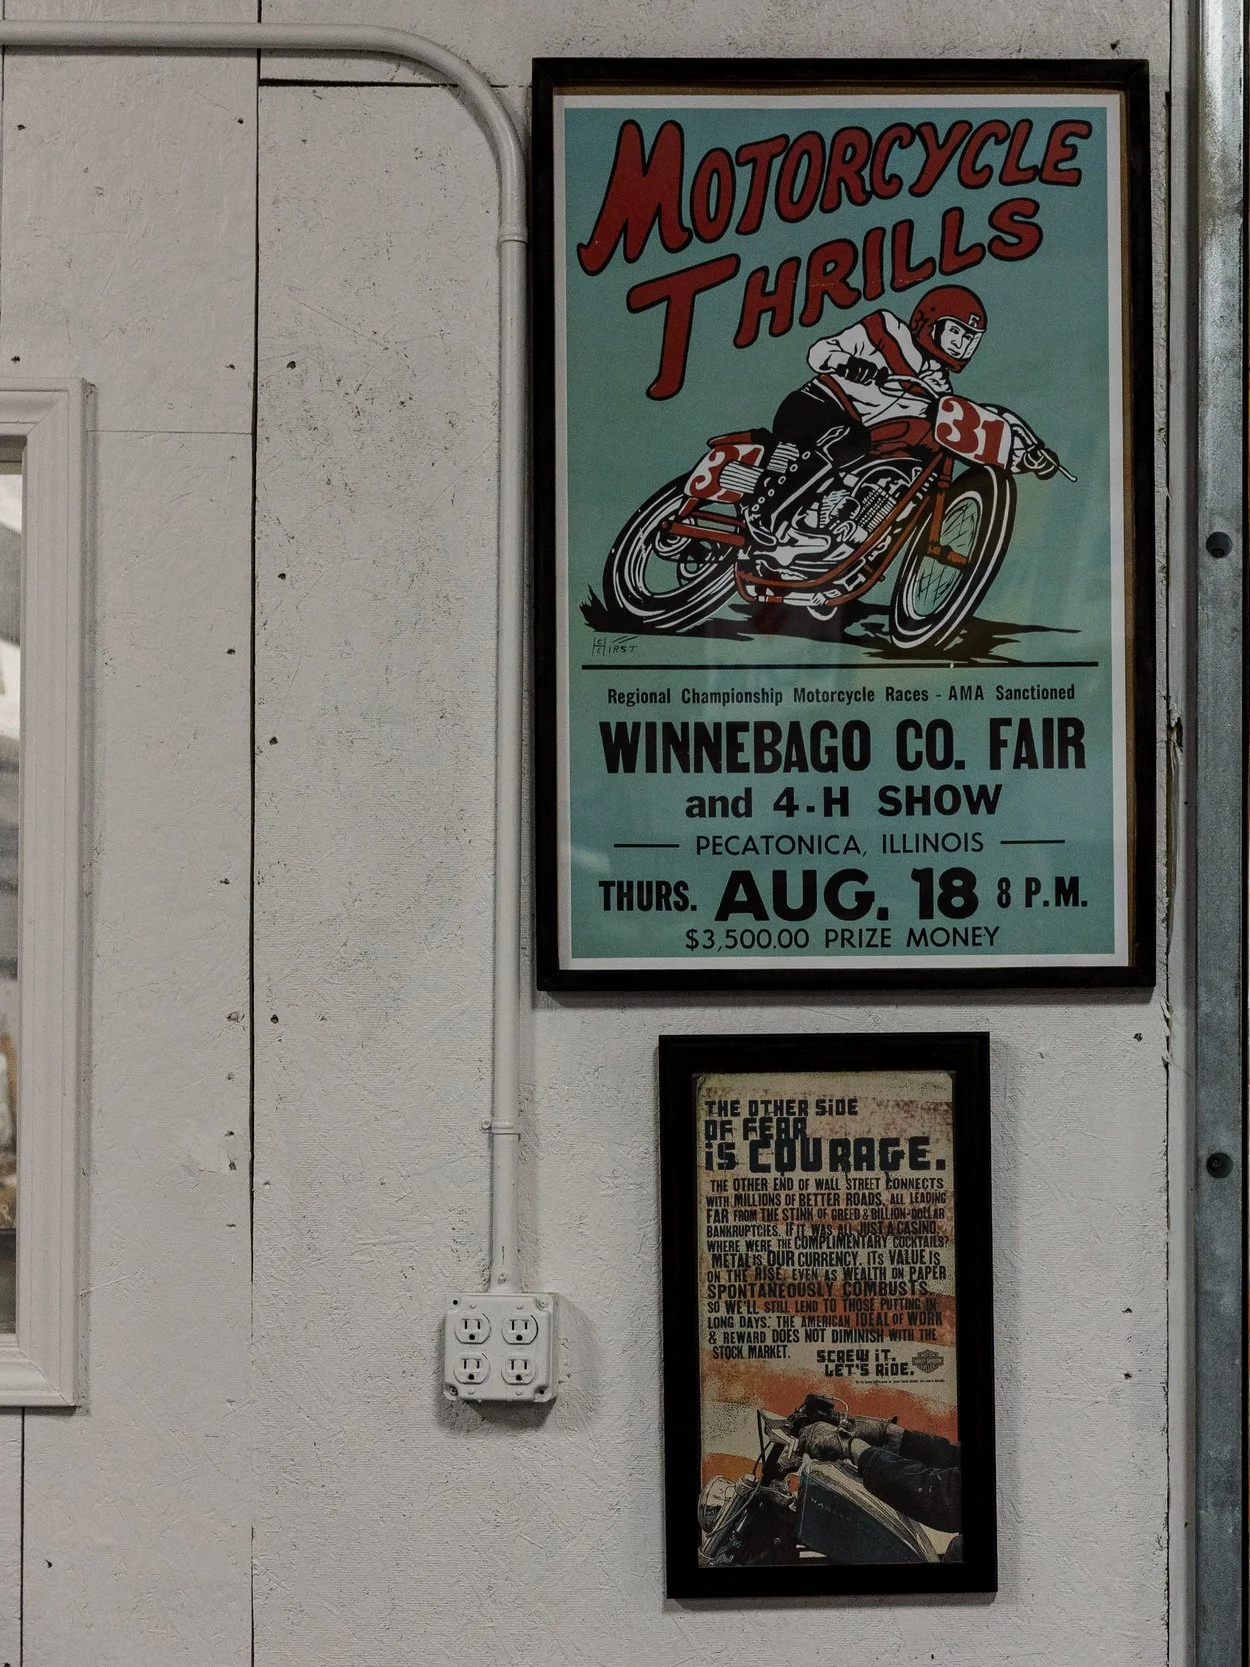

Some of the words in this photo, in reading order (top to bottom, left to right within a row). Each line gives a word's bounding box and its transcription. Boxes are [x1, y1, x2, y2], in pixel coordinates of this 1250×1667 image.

[577, 119, 1092, 276] MOTORCYCLE
[626, 198, 1043, 400] THRILLS
[936, 395, 1007, 470] 31
[608, 688, 671, 707] Regional
[681, 687, 783, 706] Championship
[794, 685, 875, 705] Motorcycle
[885, 686, 929, 701] Races
[948, 685, 984, 701] AMA
[996, 684, 1075, 700] Sanctioned
[599, 719, 871, 773] WINNEBAGO
[896, 718, 965, 771] CO.
[989, 717, 1086, 770] FAIR
[685, 787, 752, 818] and
[878, 784, 1002, 816] SHOW
[696, 835, 867, 857] PECATONICA,
[882, 832, 984, 854] ILLINOIS
[598, 880, 697, 911] THURS.
[714, 868, 889, 921] AUG.
[910, 867, 979, 920] 18
[997, 877, 1011, 908] 8
[1025, 876, 1087, 908] P.M.
[685, 928, 809, 952] $3,500.00
[825, 928, 892, 948] PRIZE
[906, 926, 1000, 947] MONEY
[705, 1100, 740, 1117] THE
[748, 1099, 808, 1117] OTHER
[705, 1119, 734, 1141] OF
[743, 1117, 807, 1141] FEAR
[749, 1136, 946, 1174] COURAGE.
[710, 1179, 728, 1192] THE
[732, 1178, 768, 1191] OTHER
[773, 1178, 794, 1191] END
[798, 1179, 810, 1191] OF
[815, 1178, 841, 1191] WALL
[846, 1178, 880, 1190] STREET
[886, 1178, 944, 1189] CONNECTS
[706, 1196, 729, 1207] WITH
[734, 1193, 781, 1207] MILLIONS
[785, 1194, 796, 1206] OF
[799, 1193, 840, 1206] BETTER
[890, 1194, 906, 1204] ALL
[910, 1192, 947, 1204] LEADING
[706, 1209, 729, 1223] FAR
[734, 1210, 757, 1221] FROM
[761, 1208, 779, 1221] THE
[782, 1208, 813, 1221] STINK
[818, 1208, 827, 1219] OF
[831, 1208, 860, 1220] GREED
[863, 1209, 869, 1220] &
[871, 1207, 945, 1220] BILLION-DOLLAR
[707, 1225, 781, 1237] BANKRUPTCIES.
[786, 1222, 794, 1236] IF
[797, 1224, 805, 1236] IT
[811, 1224, 832, 1237] WAS
[838, 1223, 853, 1235] ALL
[858, 1221, 883, 1236] JUST
[886, 1221, 894, 1235] A
[707, 1240, 740, 1252] WHERE
[745, 1240, 771, 1252] WERE
[777, 1239, 792, 1249] THE
[794, 1235, 887, 1249] COMPLIMENTARY
[893, 1236, 949, 1249] COCKTAILS?
[712, 1253, 751, 1268] METAL
[753, 1254, 762, 1265] IS
[767, 1250, 795, 1267] OUR
[797, 1251, 862, 1267] CURRENCY.
[889, 1249, 926, 1265] VALUE
[929, 1252, 941, 1265] IS
[707, 1271, 720, 1283] ON
[727, 1270, 748, 1280] THE
[792, 1269, 818, 1281] EVEN
[825, 1269, 837, 1281] AS
[843, 1267, 886, 1281] WEALTH
[892, 1268, 904, 1279] ON
[909, 1266, 947, 1280] PAPER
[708, 1282, 833, 1299] SPONTANEOUSLY
[843, 1280, 933, 1297] COMBUSTS.
[708, 1301, 720, 1313] SO
[724, 1300, 759, 1314] WE'LL
[764, 1301, 790, 1313] STILL
[795, 1300, 818, 1313] LEND
[823, 1298, 836, 1312] TO
[843, 1298, 875, 1312] THOSE
[881, 1298, 920, 1311] PUTTING
[925, 1297, 937, 1311] IN
[708, 1316, 734, 1329] LONG
[776, 1315, 795, 1328] THE
[801, 1315, 850, 1327] AMERICAN
[856, 1311, 889, 1326] IDEAL
[892, 1313, 904, 1324] OF
[907, 1312, 943, 1325] WORK
[708, 1331, 716, 1344] &
[723, 1331, 766, 1344] REWARD
[772, 1329, 799, 1343] DOES
[805, 1329, 826, 1342] NOT
[832, 1329, 883, 1343] DIMINISH
[889, 1328, 914, 1341] WITH
[919, 1329, 936, 1340] THE
[713, 1345, 743, 1359] STOCK
[748, 1345, 790, 1359] MARKET.
[817, 1349, 869, 1362] SCREW
[825, 1363, 869, 1376] LET'S
